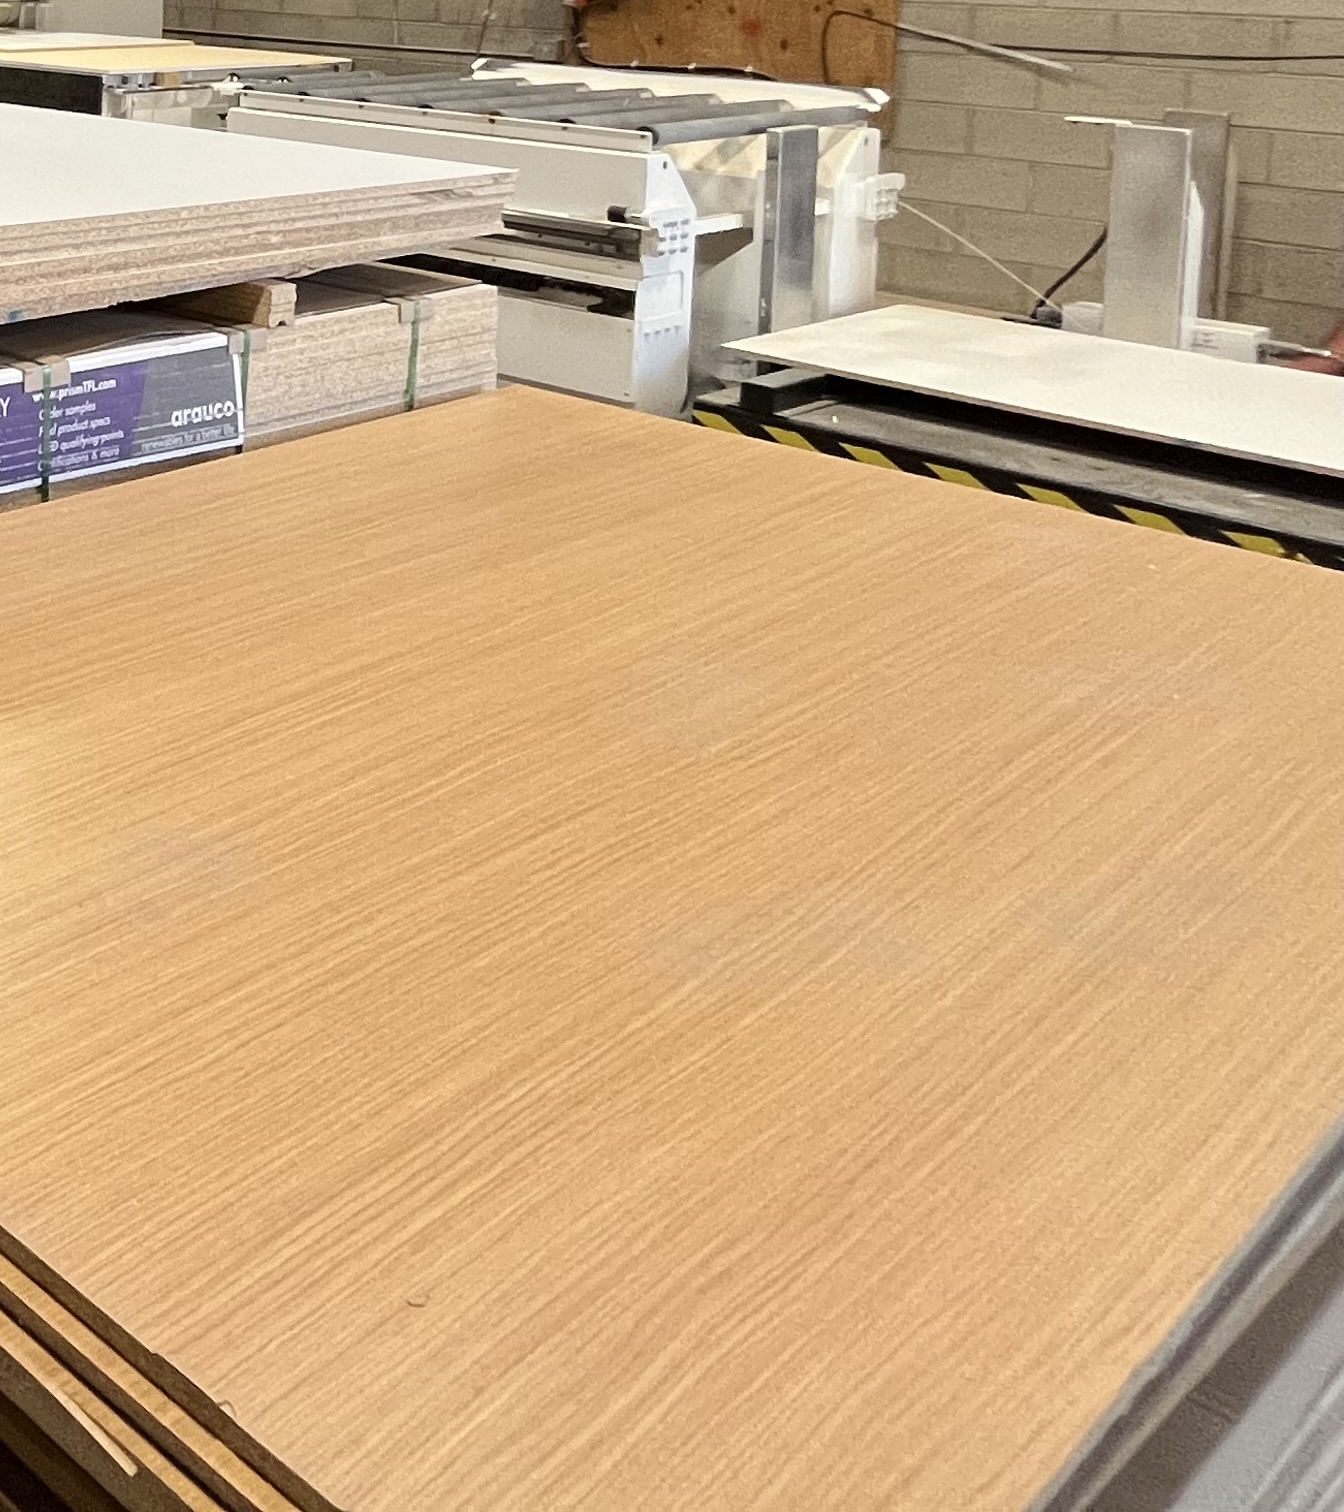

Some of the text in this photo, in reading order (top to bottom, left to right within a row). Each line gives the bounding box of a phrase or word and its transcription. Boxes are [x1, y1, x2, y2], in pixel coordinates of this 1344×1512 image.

[171, 400, 235, 427] arauco
[38, 422, 58, 438] Fd
[57, 418, 89, 438] product
